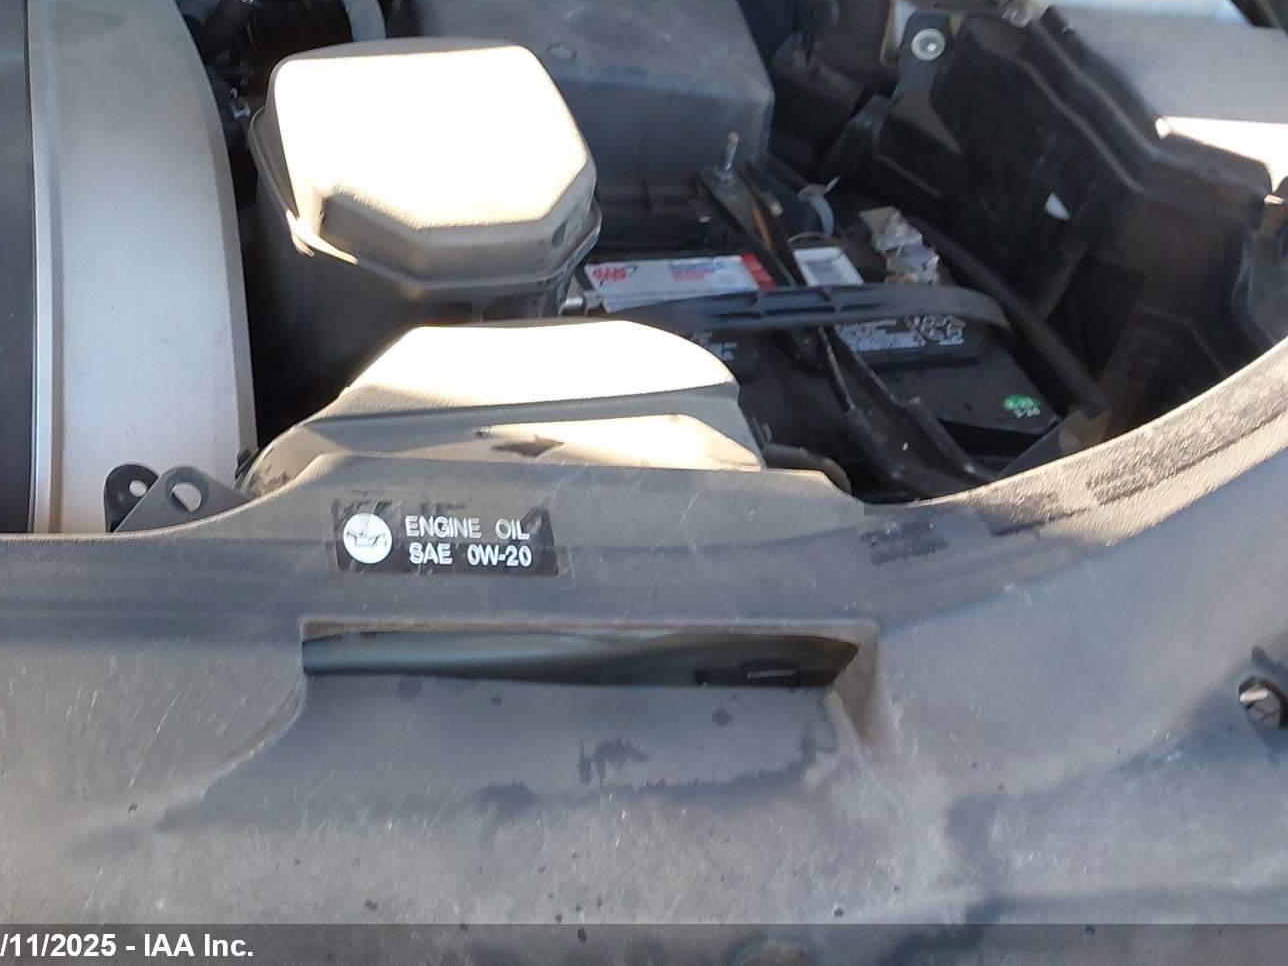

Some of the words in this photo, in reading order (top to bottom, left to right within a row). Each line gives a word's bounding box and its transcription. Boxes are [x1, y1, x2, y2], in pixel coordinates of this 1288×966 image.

[404, 514, 482, 539] ENGINE
[494, 518, 538, 541] OIL
[408, 541, 458, 565] SAE
[466, 543, 532, 567] 0W-20
